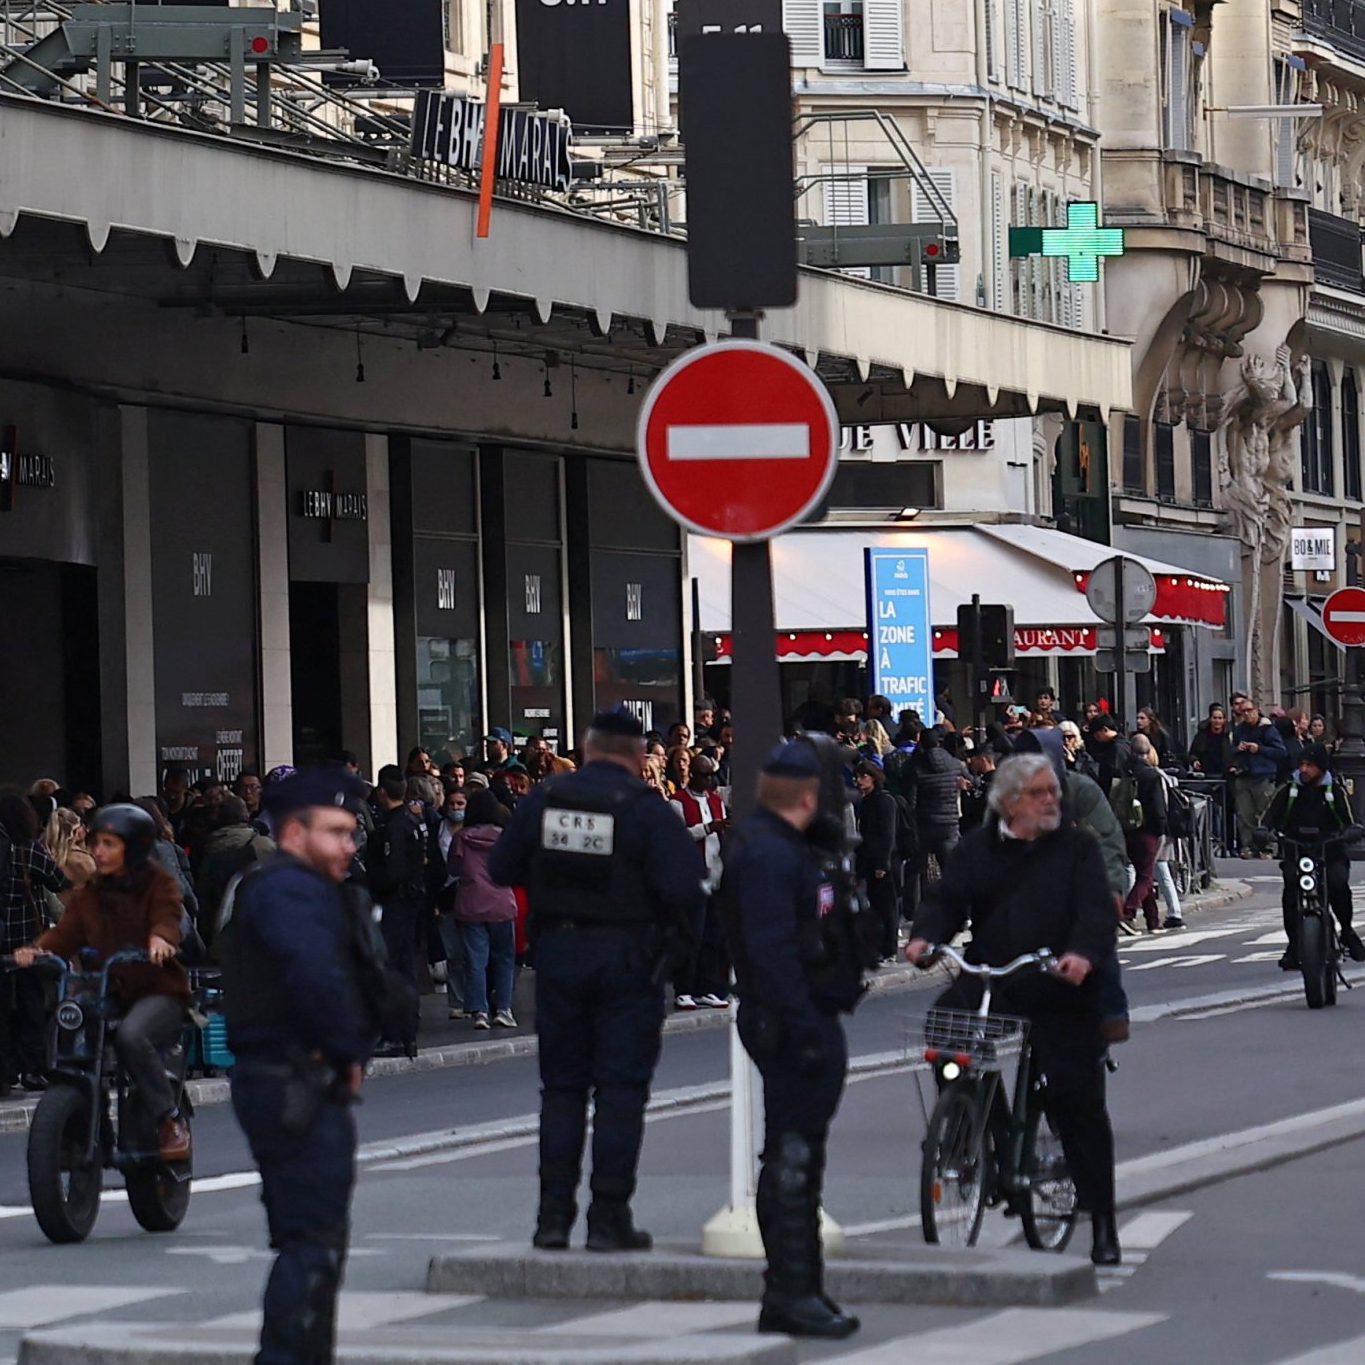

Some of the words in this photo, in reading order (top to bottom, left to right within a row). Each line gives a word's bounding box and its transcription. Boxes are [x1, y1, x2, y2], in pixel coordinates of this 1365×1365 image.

[421, 89, 447, 162] LE
[499, 107, 573, 193] MARAIS
[18, 454, 55, 487] MARAIS
[303, 490, 314, 517] LE
[314, 490, 332, 518] BHV
[192, 551, 213, 599] BHV
[437, 568, 455, 610] BHV
[524, 574, 541, 614] BHV
[626, 583, 642, 621] BHV
[879, 600, 896, 619] LA
[879, 625, 915, 644] ZONE
[880, 647, 892, 669] À
[881, 676, 927, 694] TRAFIC
